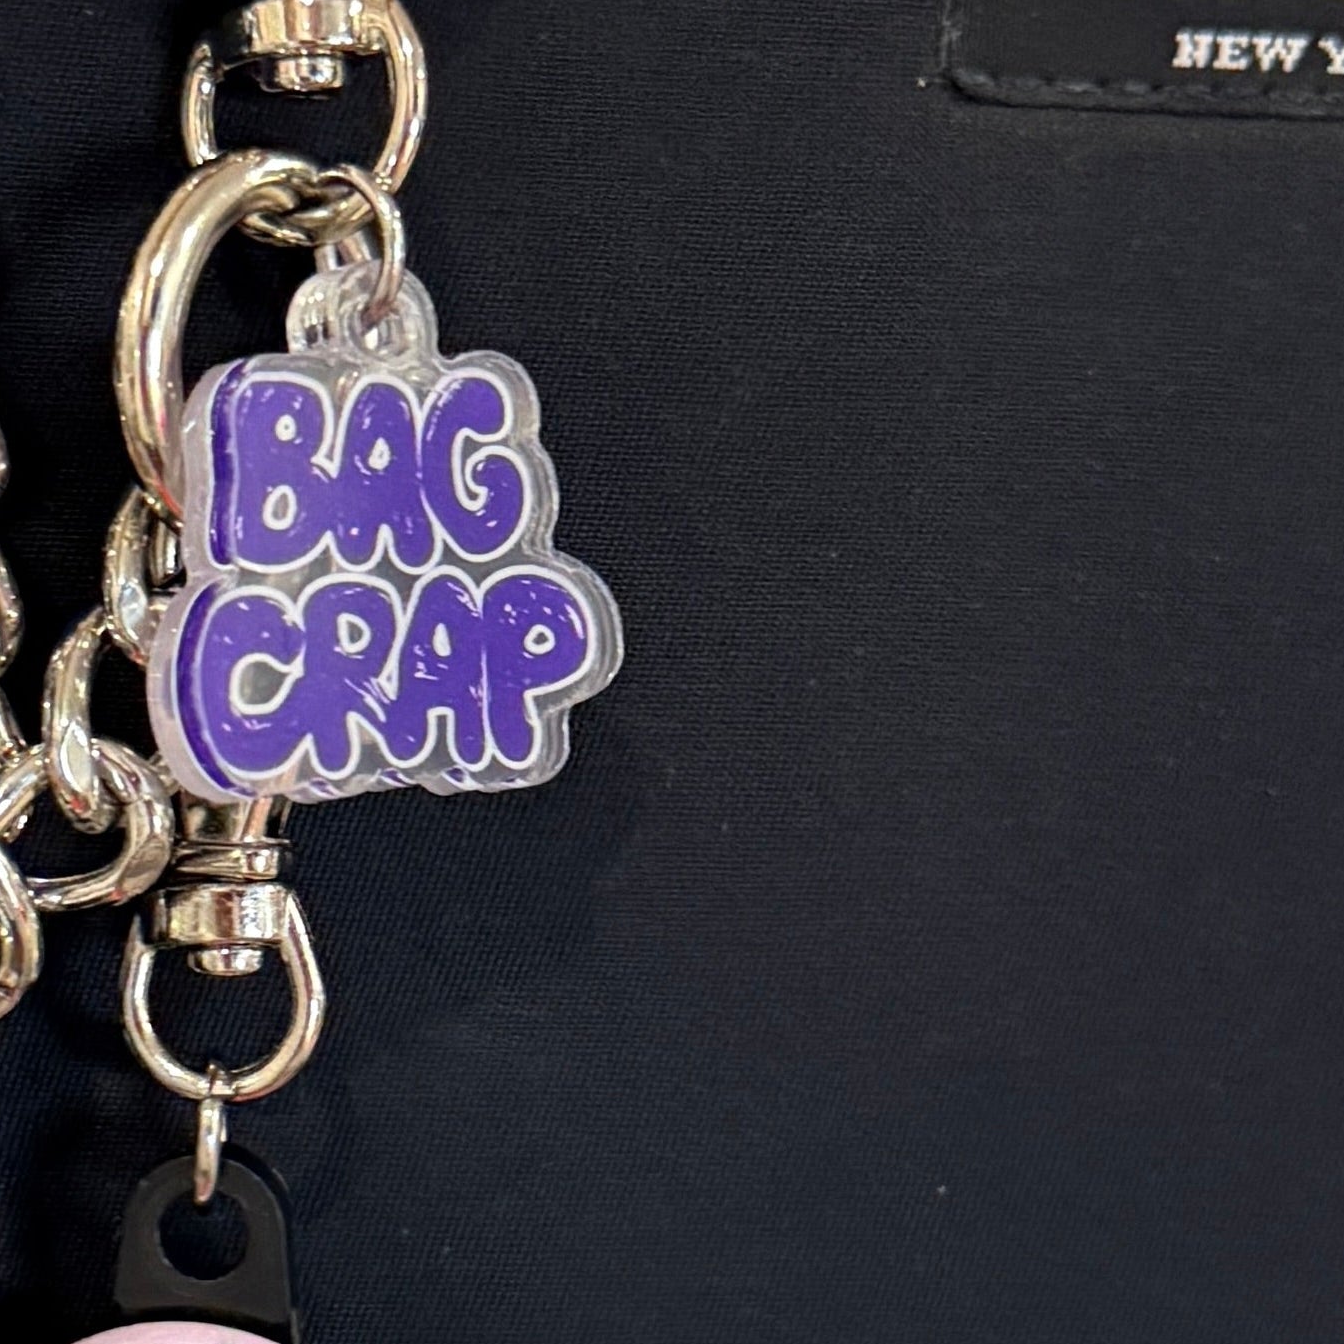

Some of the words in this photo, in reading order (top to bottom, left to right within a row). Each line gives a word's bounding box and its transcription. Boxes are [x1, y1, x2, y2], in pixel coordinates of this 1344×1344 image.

[1171, 29, 1306, 71] NEW
[210, 365, 532, 575] BAG
[177, 565, 597, 780] CRAP
